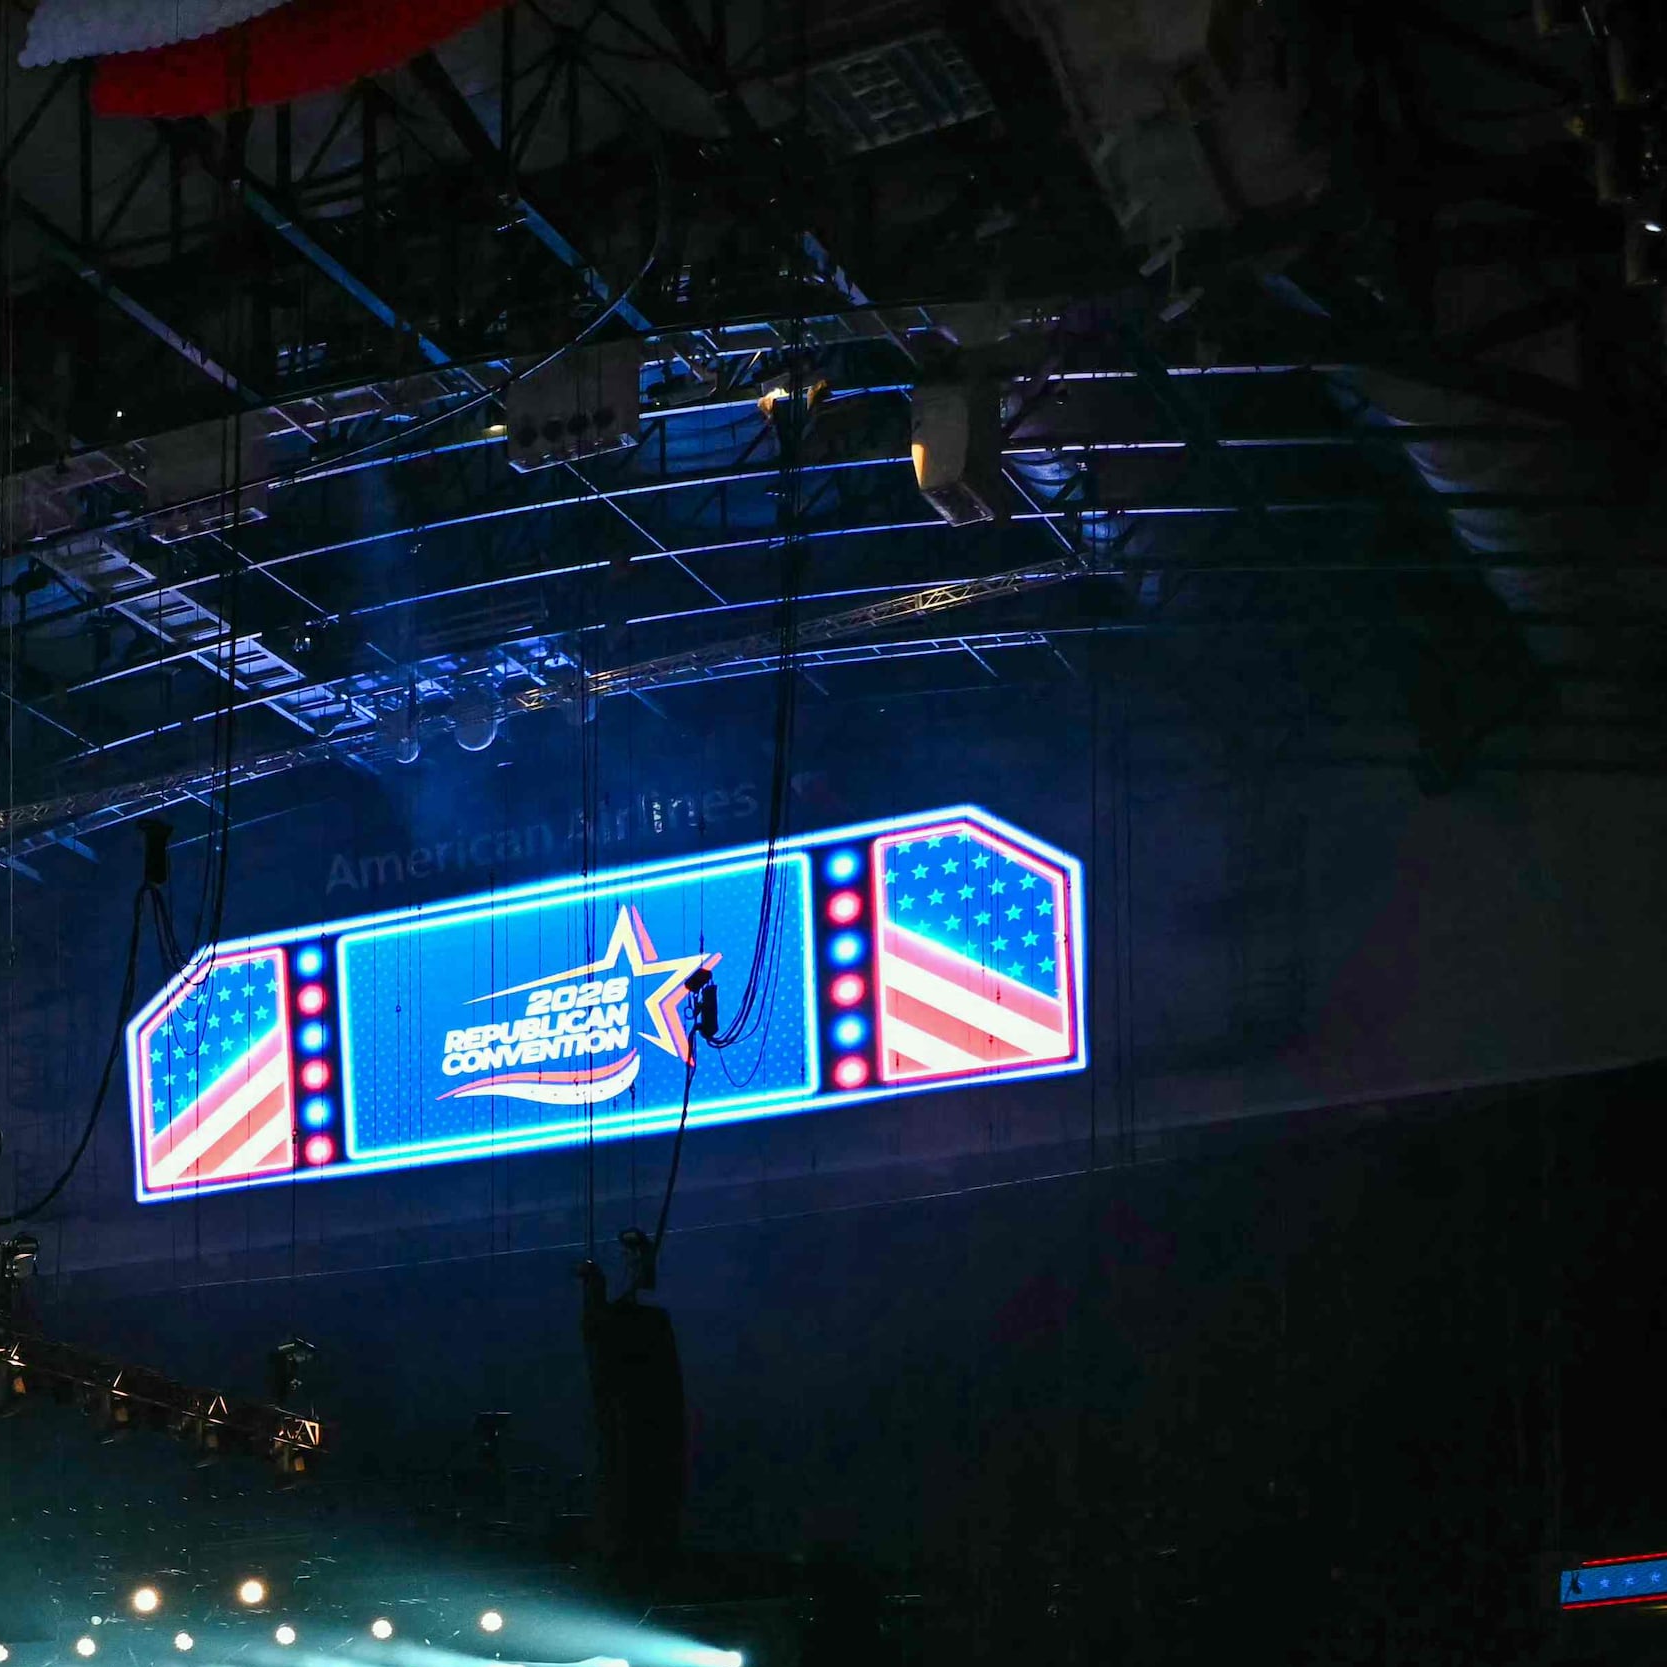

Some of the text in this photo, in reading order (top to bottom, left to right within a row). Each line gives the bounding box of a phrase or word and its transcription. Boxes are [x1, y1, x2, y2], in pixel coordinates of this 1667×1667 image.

[525, 976, 630, 1017] 2026
[441, 1025, 631, 1077] CONVENTION
[443, 1003, 630, 1054] REPUBLICAN
